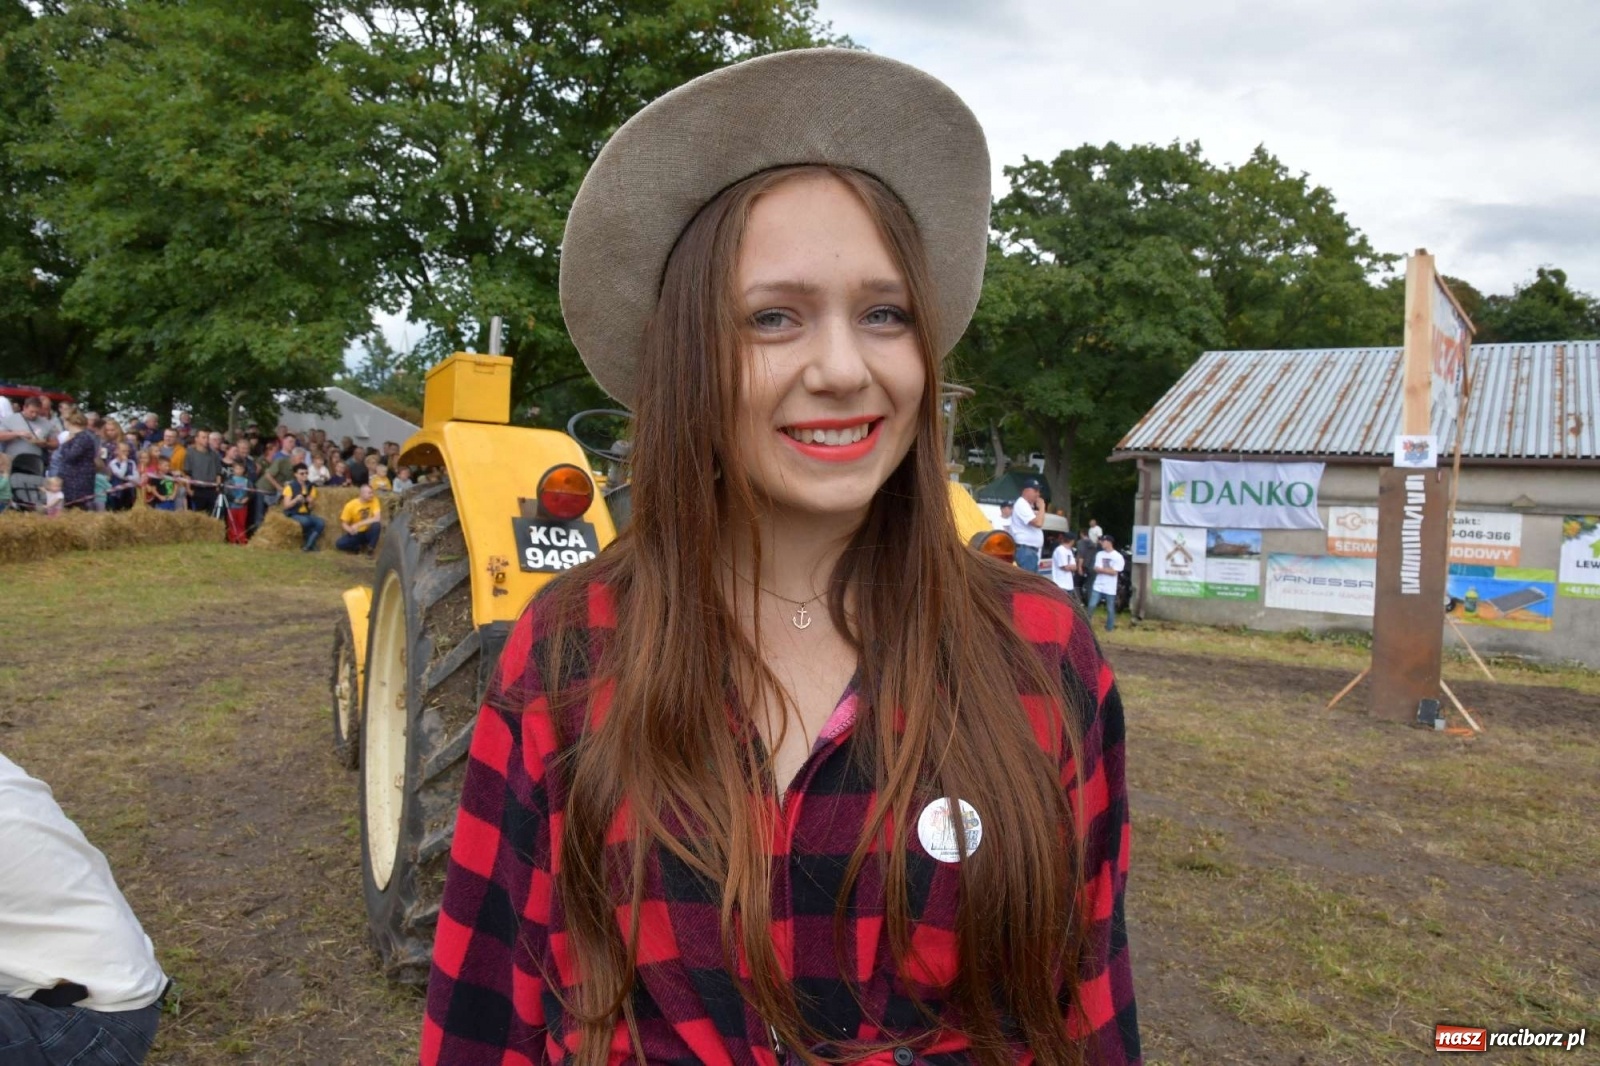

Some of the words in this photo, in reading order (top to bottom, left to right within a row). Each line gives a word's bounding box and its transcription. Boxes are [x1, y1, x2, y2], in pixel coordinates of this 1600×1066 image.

[1190, 479, 1315, 508] DANKO
[529, 525, 587, 548] KCA
[1273, 574, 1374, 588] VANESSA
